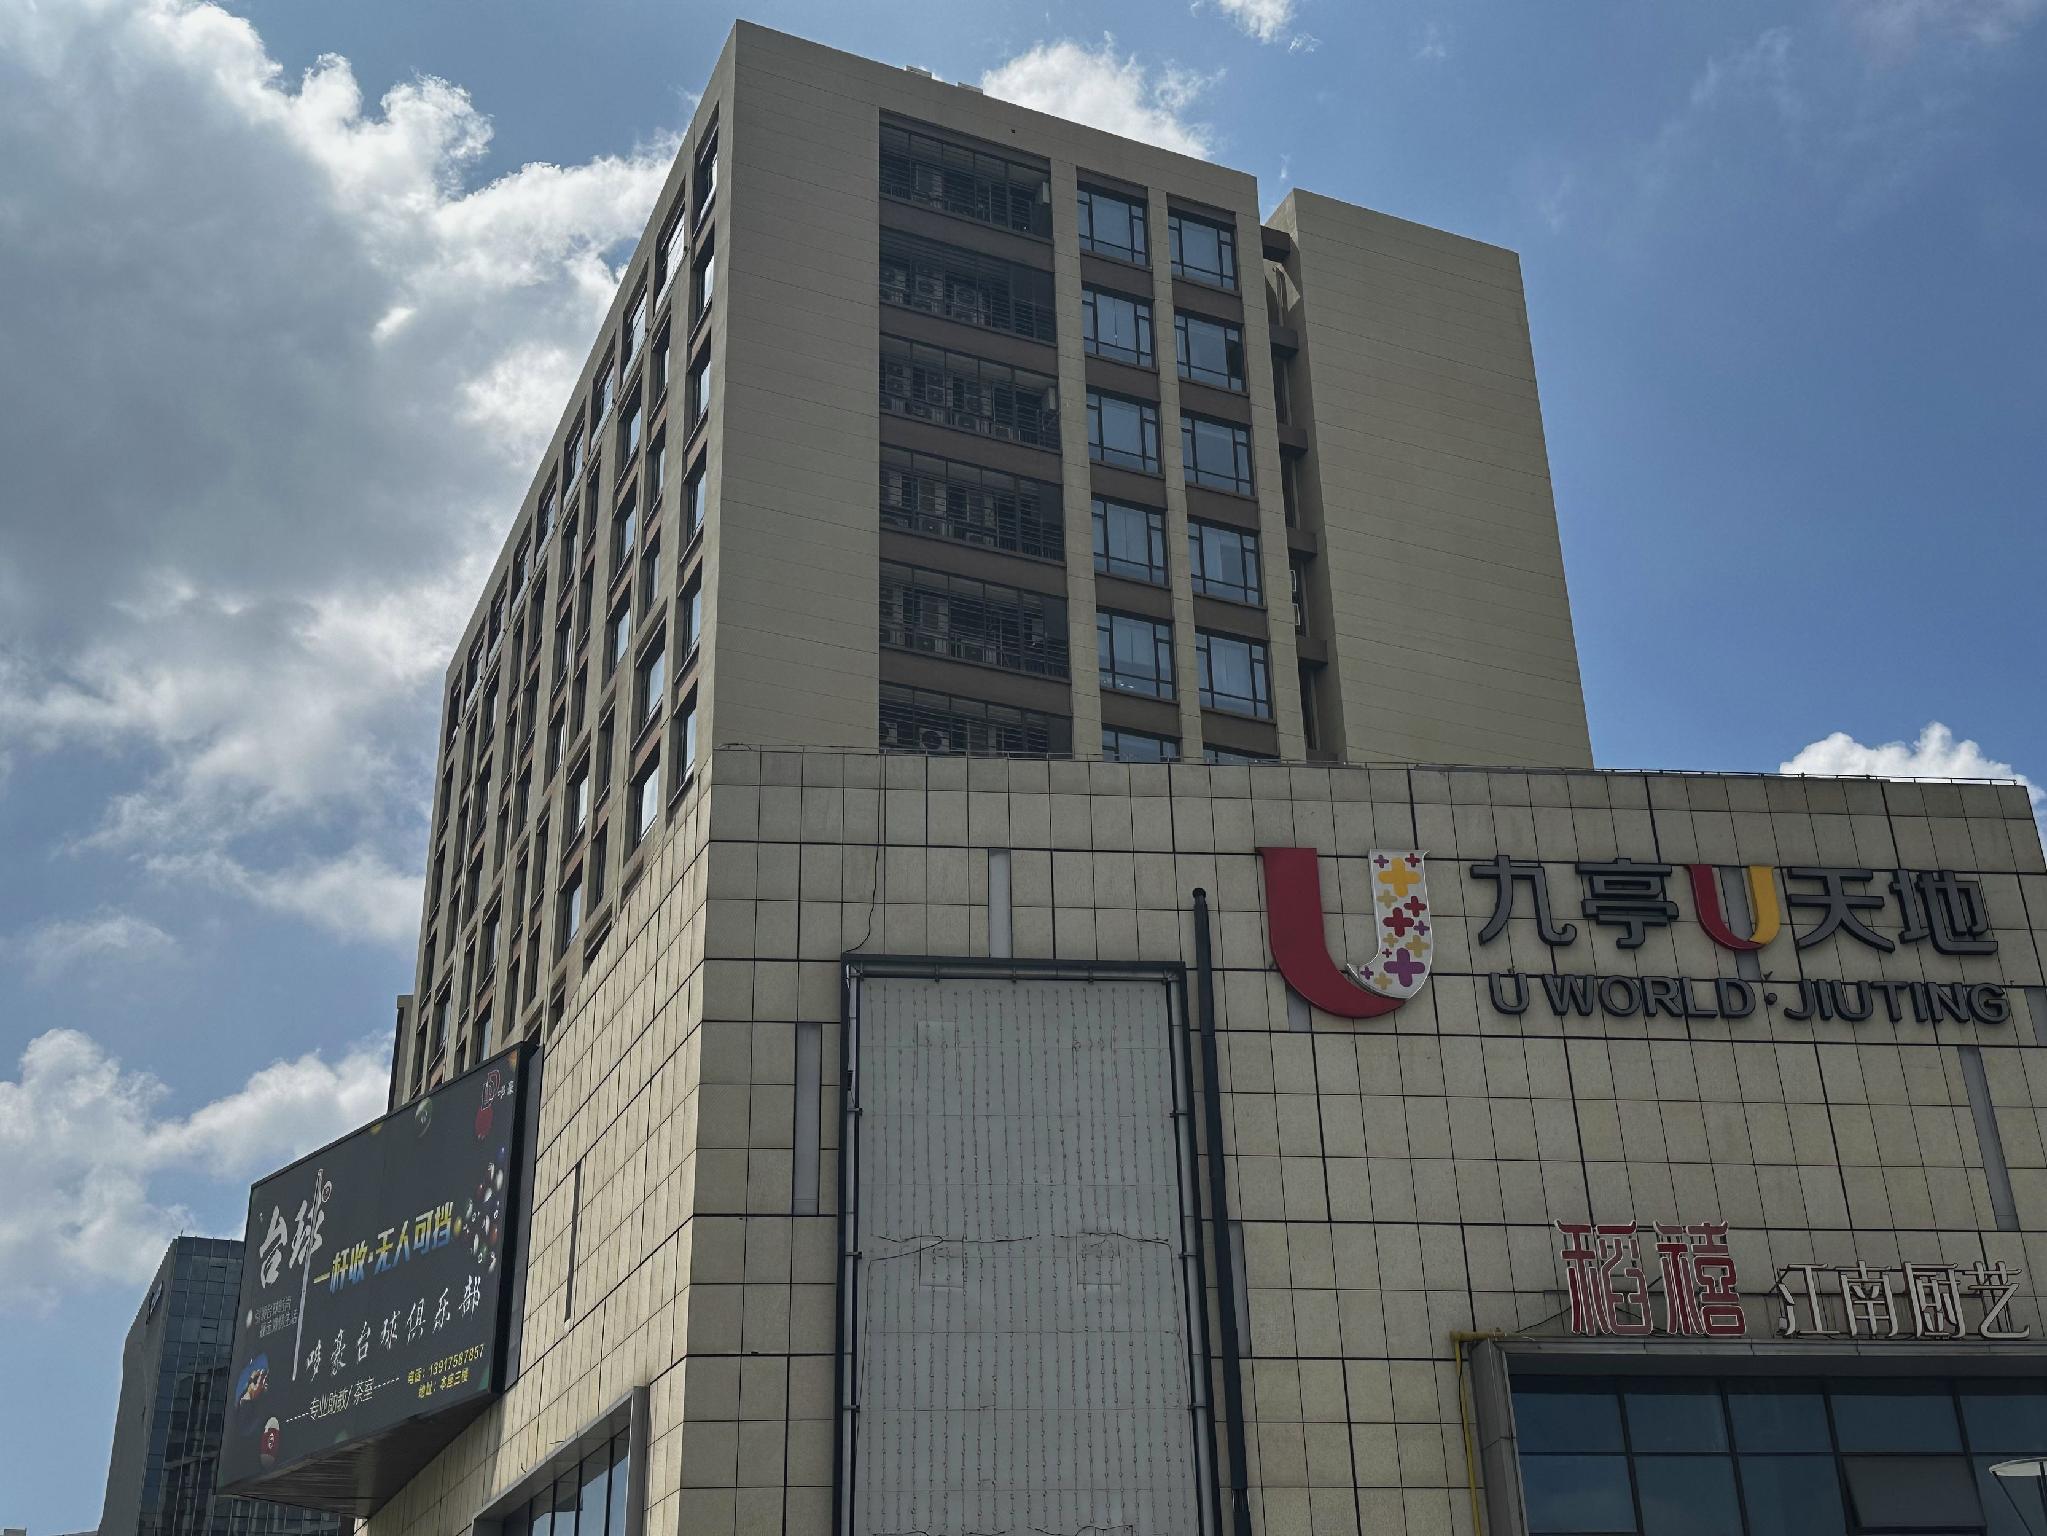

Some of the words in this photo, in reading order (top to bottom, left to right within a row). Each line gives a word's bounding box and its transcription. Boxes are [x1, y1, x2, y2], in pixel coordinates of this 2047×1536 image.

[1470, 855, 1998, 956] 九亭U天地
[1488, 972, 1530, 1016] U
[259, 1168, 326, 1292] 台球
[1774, 1259, 2031, 1340] 江南厨艺
